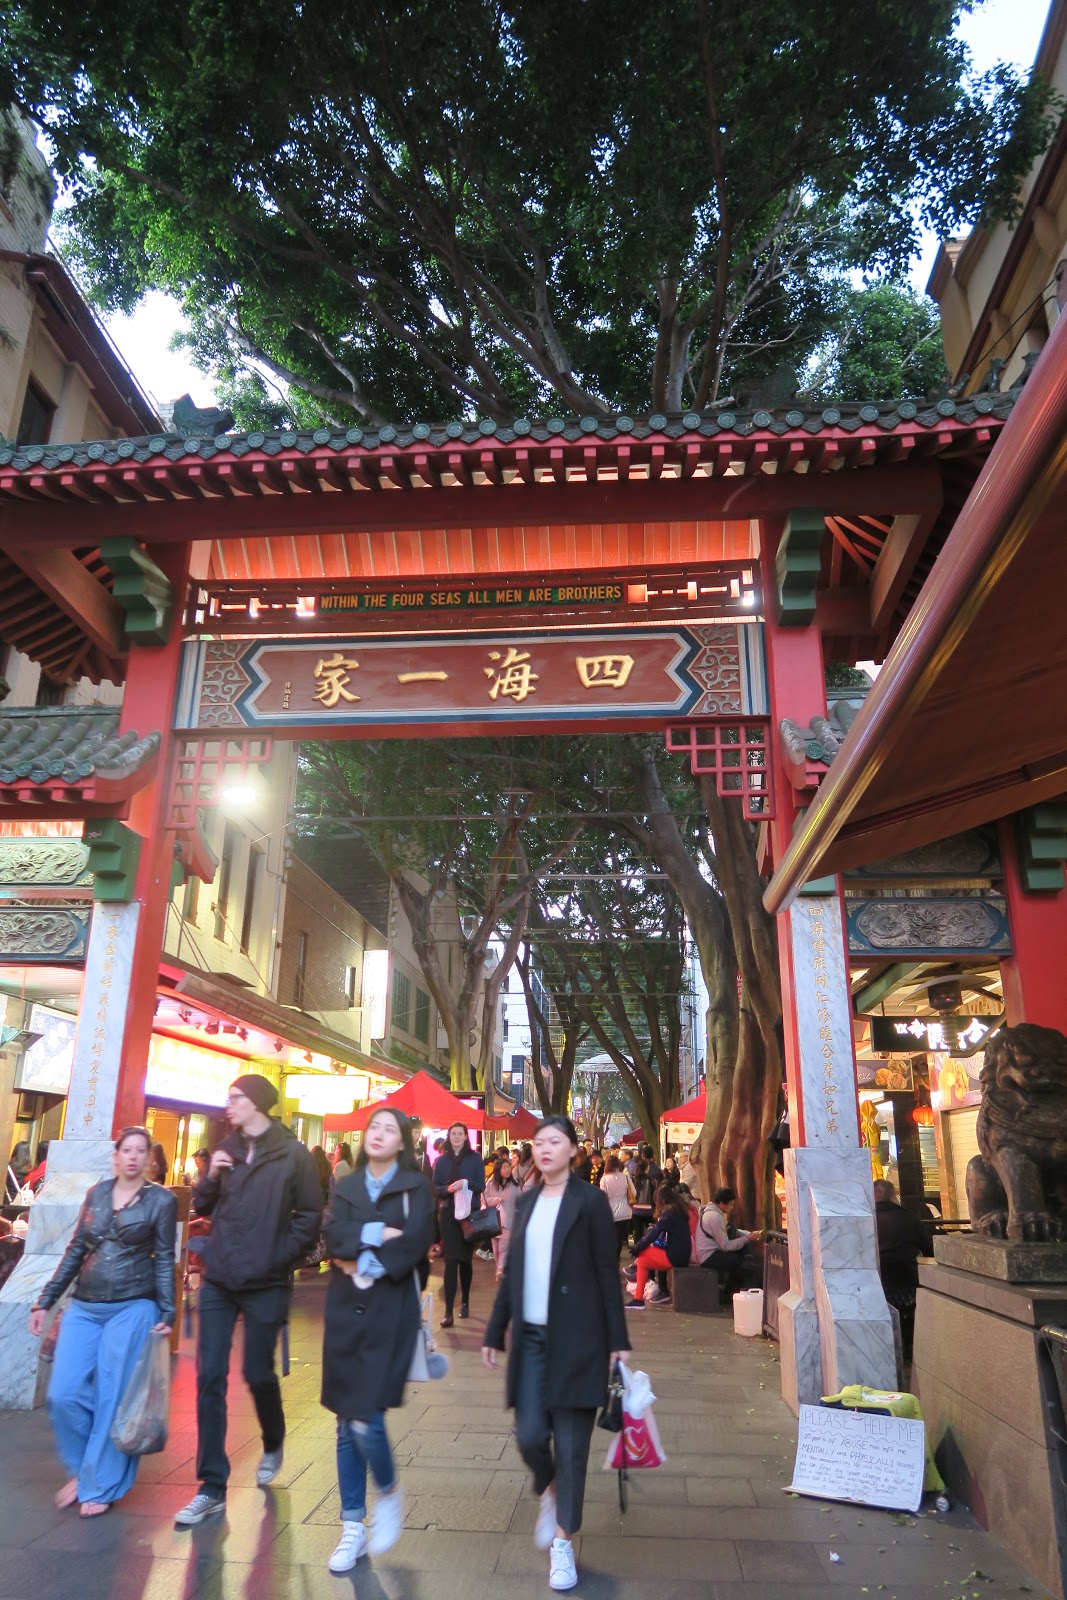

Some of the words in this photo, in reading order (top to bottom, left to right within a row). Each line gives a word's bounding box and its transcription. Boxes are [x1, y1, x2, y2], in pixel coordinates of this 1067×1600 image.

[320, 592, 361, 608] WITHIN
[364, 591, 389, 607] THE
[392, 591, 424, 607] FOUR
[430, 591, 462, 606] SEAS
[468, 590, 492, 604] ALL
[496, 589, 523, 604] MEN
[528, 588, 555, 602] ARE
[558, 585, 621, 601] BROTHERS
[804, 1410, 854, 1430] PLEASE
[864, 1418, 893, 1436] HELP
[801, 1443, 834, 1457] MENTALLY
[850, 1451, 894, 1467] PHYSICALLY
[841, 1438, 868, 1449] ABUSE
